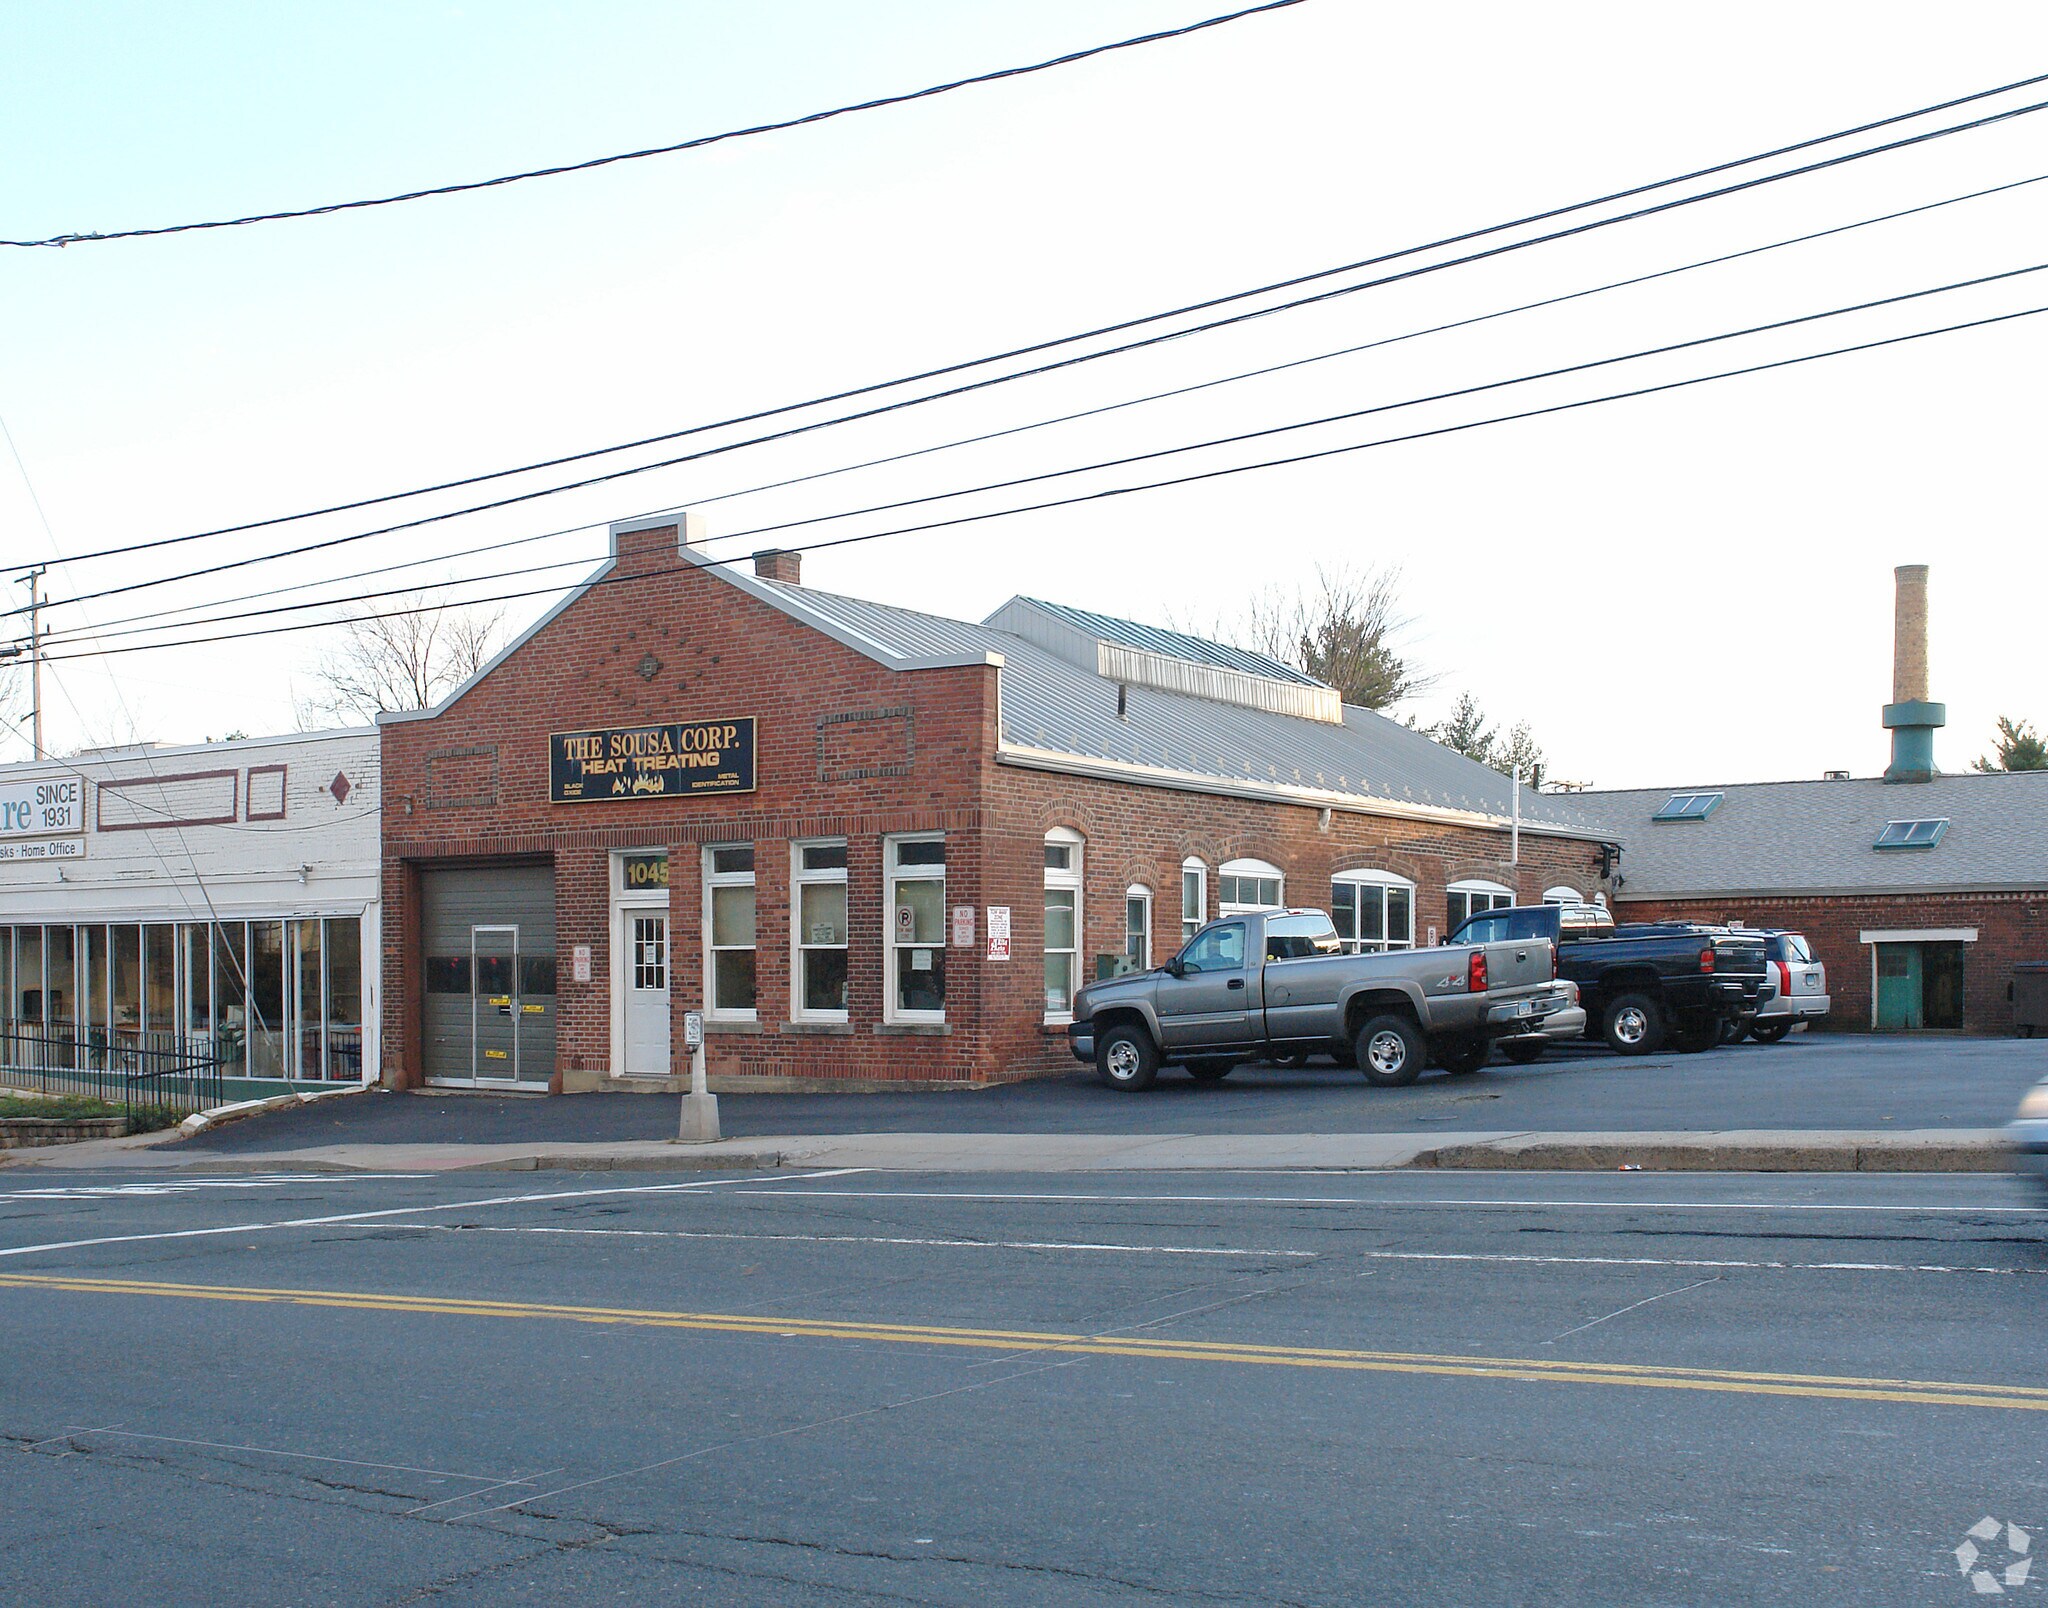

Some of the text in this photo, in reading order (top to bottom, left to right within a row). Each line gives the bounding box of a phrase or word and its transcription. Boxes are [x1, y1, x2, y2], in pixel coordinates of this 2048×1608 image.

[563, 726, 740, 761] THE SOUSA CORP.
[581, 751, 720, 775] HEAT TREATING
[36, 783, 77, 805] SINCE
[691, 779, 739, 788] IDENTIFICATION
[0, 800, 32, 830] re
[42, 806, 71, 827] 1931
[21, 844, 46, 857] Home
[49, 842, 76, 856] Office
[628, 862, 669, 884] 1045
[954, 918, 974, 926] PARKING
[959, 909, 969, 918] NO
